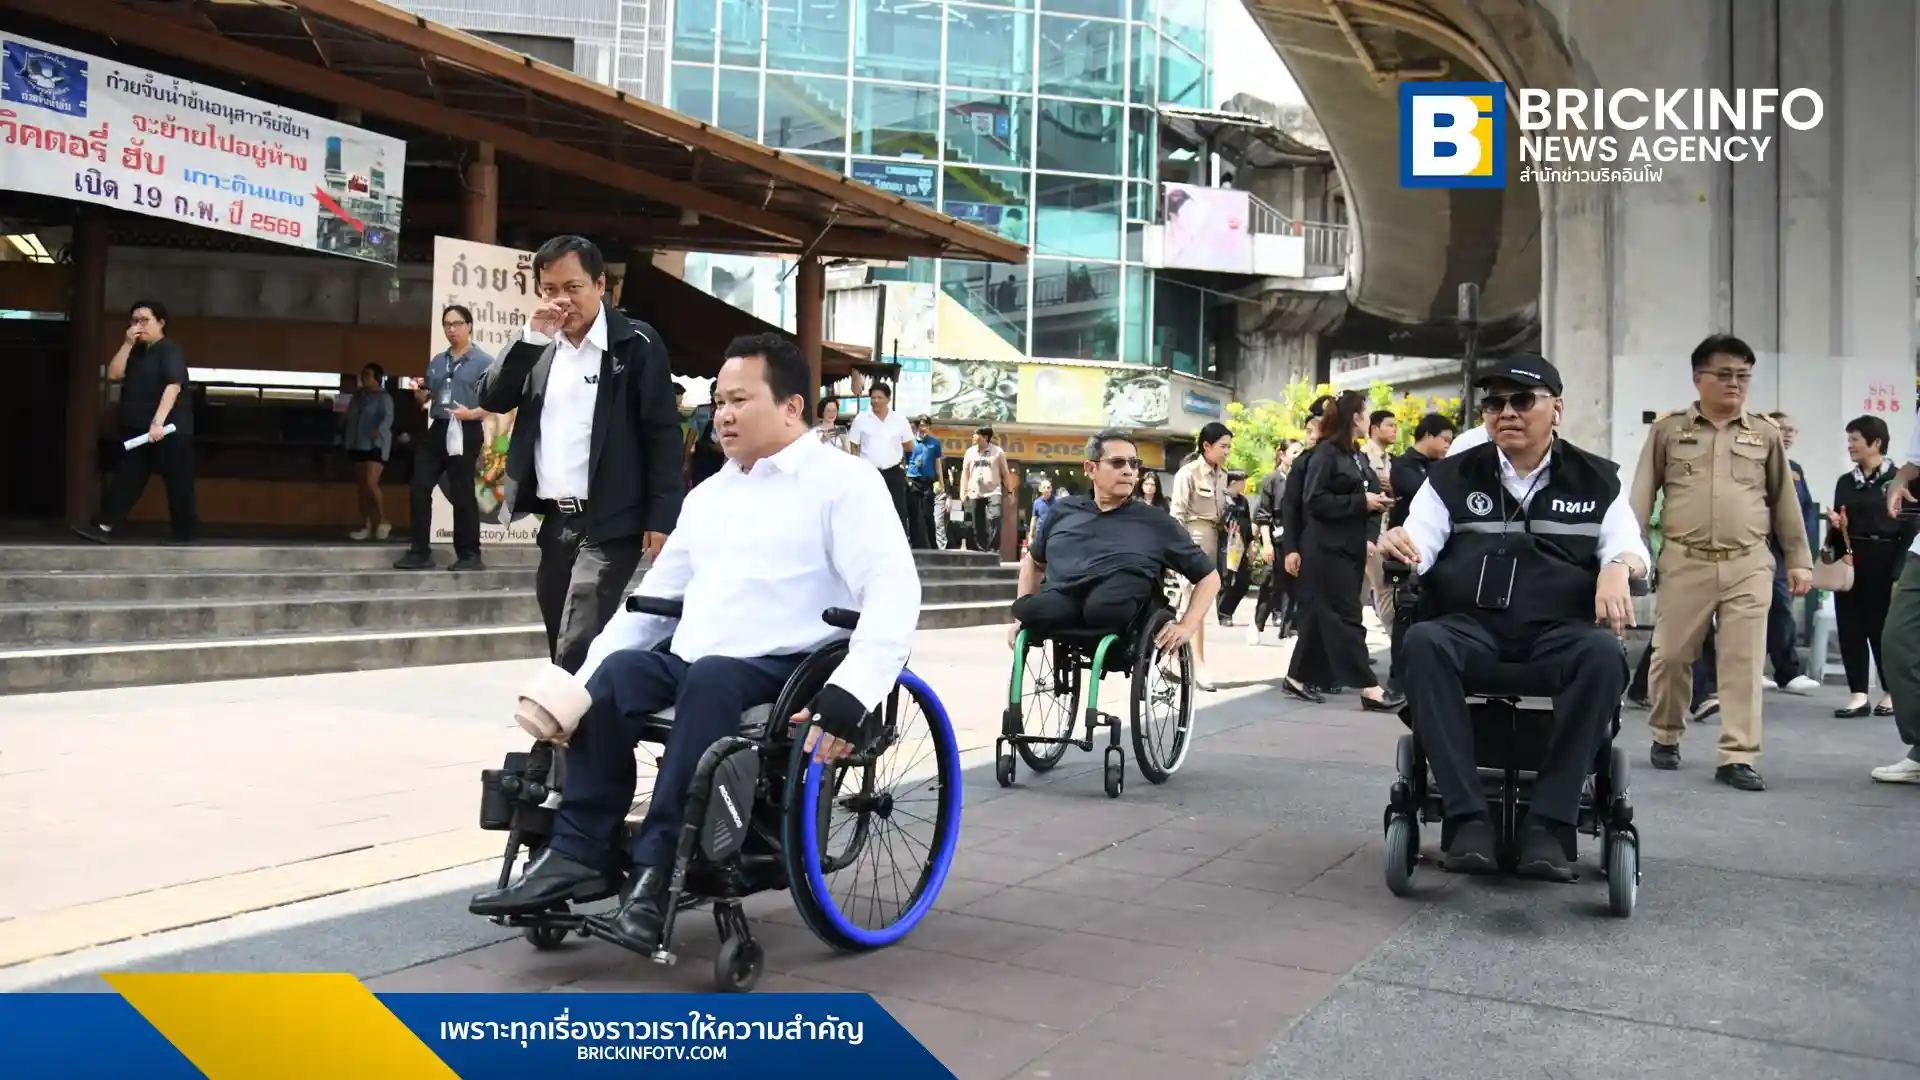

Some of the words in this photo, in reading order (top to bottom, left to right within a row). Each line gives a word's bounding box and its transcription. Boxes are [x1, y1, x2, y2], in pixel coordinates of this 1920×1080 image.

[122, 136, 166, 176] ฮับ
[132, 112, 308, 172] จะย้ายไปอยู่ห้าง
[75, 167, 119, 200] เปิด
[133, 184, 163, 209] 19
[174, 195, 220, 224] ก.พ.
[228, 198, 244, 226] ปี
[250, 212, 302, 239] 2569
[183, 166, 305, 208] เกาะดินแดง
[1551, 499, 1596, 514] กทม
[507, 528, 529, 539] Hub
